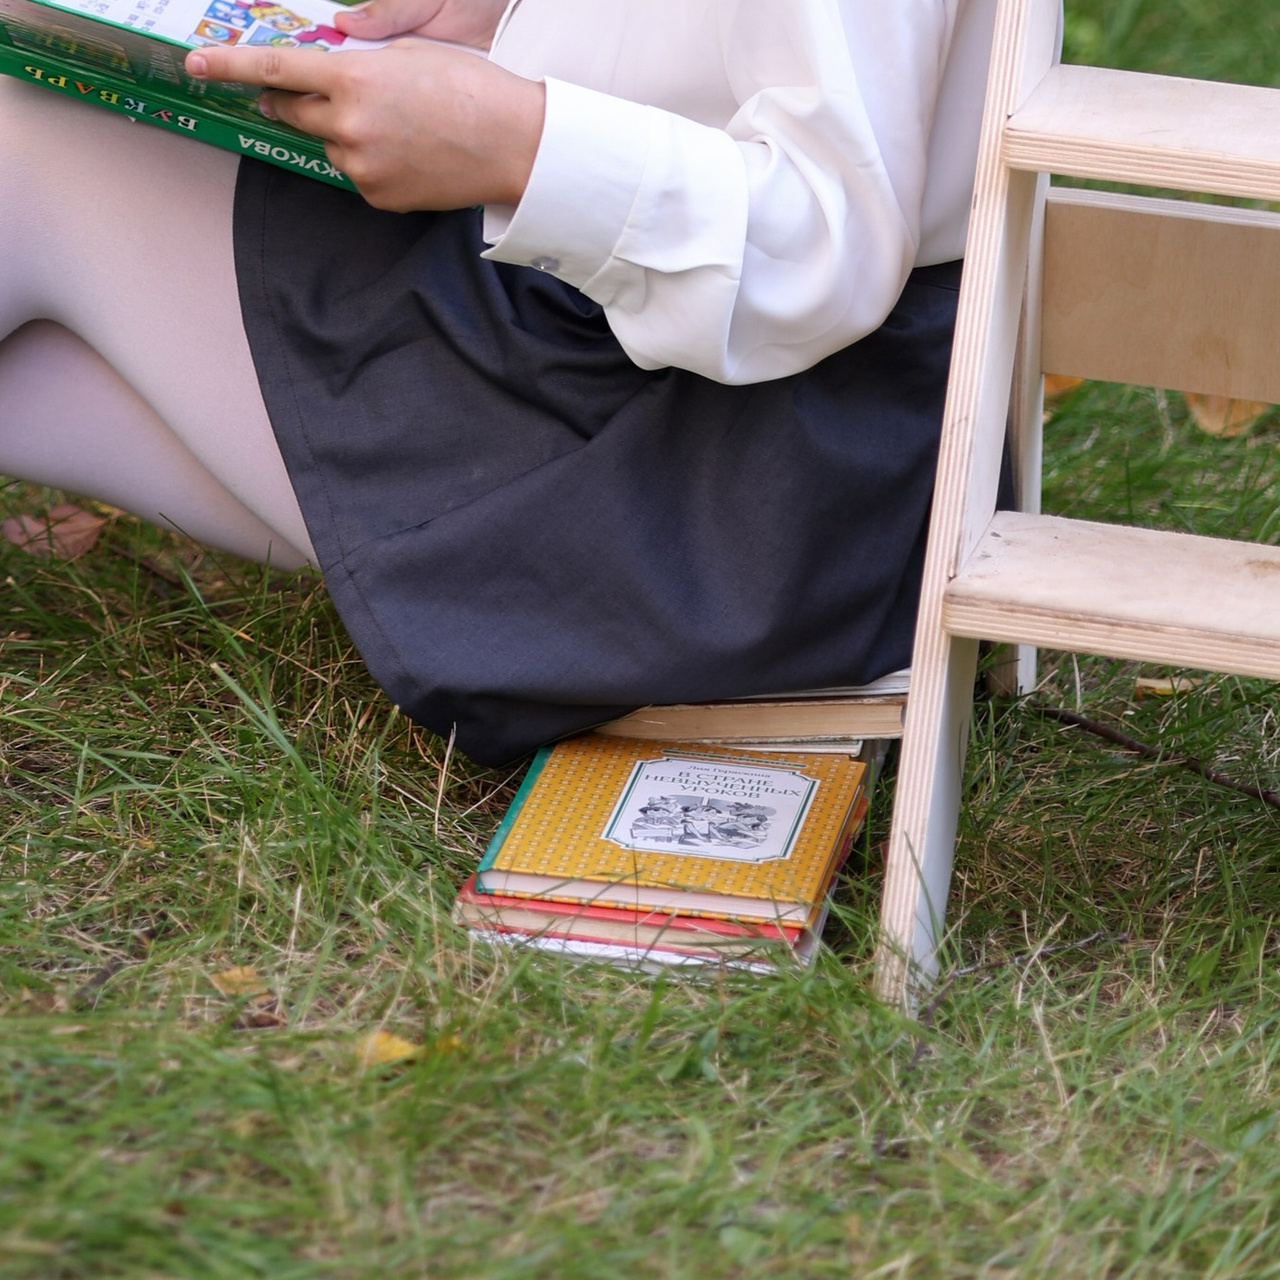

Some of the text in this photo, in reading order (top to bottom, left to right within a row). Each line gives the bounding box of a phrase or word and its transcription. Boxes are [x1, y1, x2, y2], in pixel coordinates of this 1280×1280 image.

[23, 65, 200, 132] БУКВАРЬ
[644, 774, 801, 797] НЕВЫУЧЕННЫХ
[696, 772, 775, 787] СТРАНЕ
[679, 784, 761, 799] УРОКОВ
